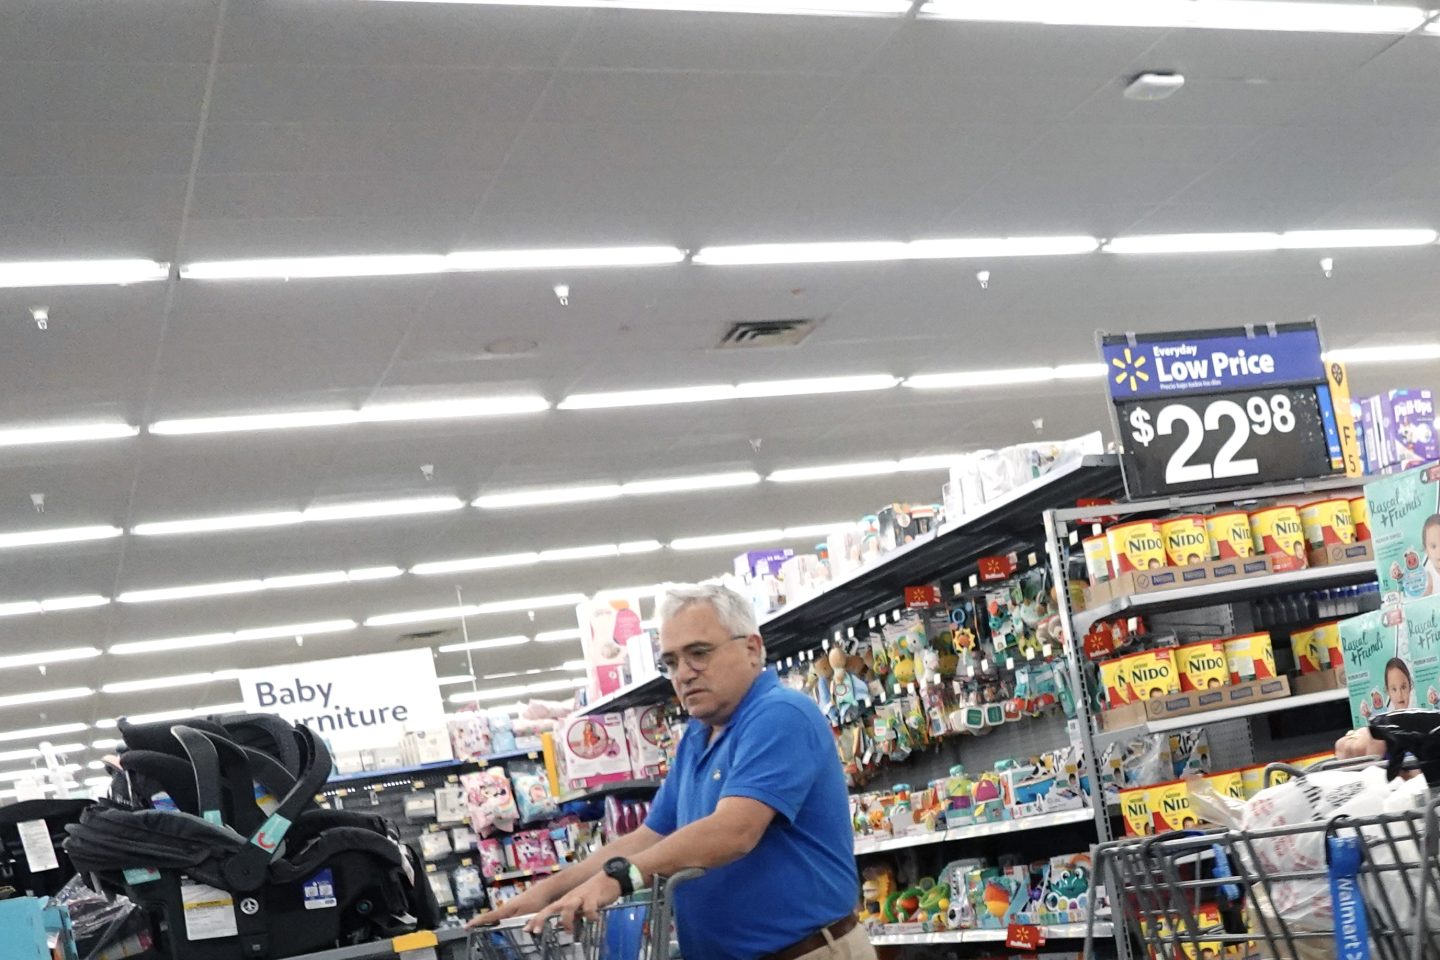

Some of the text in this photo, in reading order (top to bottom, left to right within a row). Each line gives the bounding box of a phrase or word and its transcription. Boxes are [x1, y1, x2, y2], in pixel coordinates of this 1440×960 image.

[1153, 344, 1197, 358] Everyday
[1155, 350, 1275, 384] Low Price
[1422, 471, 1428, 482] 4
[1369, 487, 1400, 517] Rascal
[1129, 537, 1162, 553] NIDO
[1169, 532, 1205, 549] NIDO
[1407, 609, 1438, 637] Rascal
[1342, 631, 1368, 652] Rascal
[1132, 666, 1169, 682] NIDO
[1189, 656, 1224, 673] NIDO
[255, 678, 332, 708] Baby
[294, 704, 408, 733] rniture
[1338, 879, 1362, 949] Walmart
